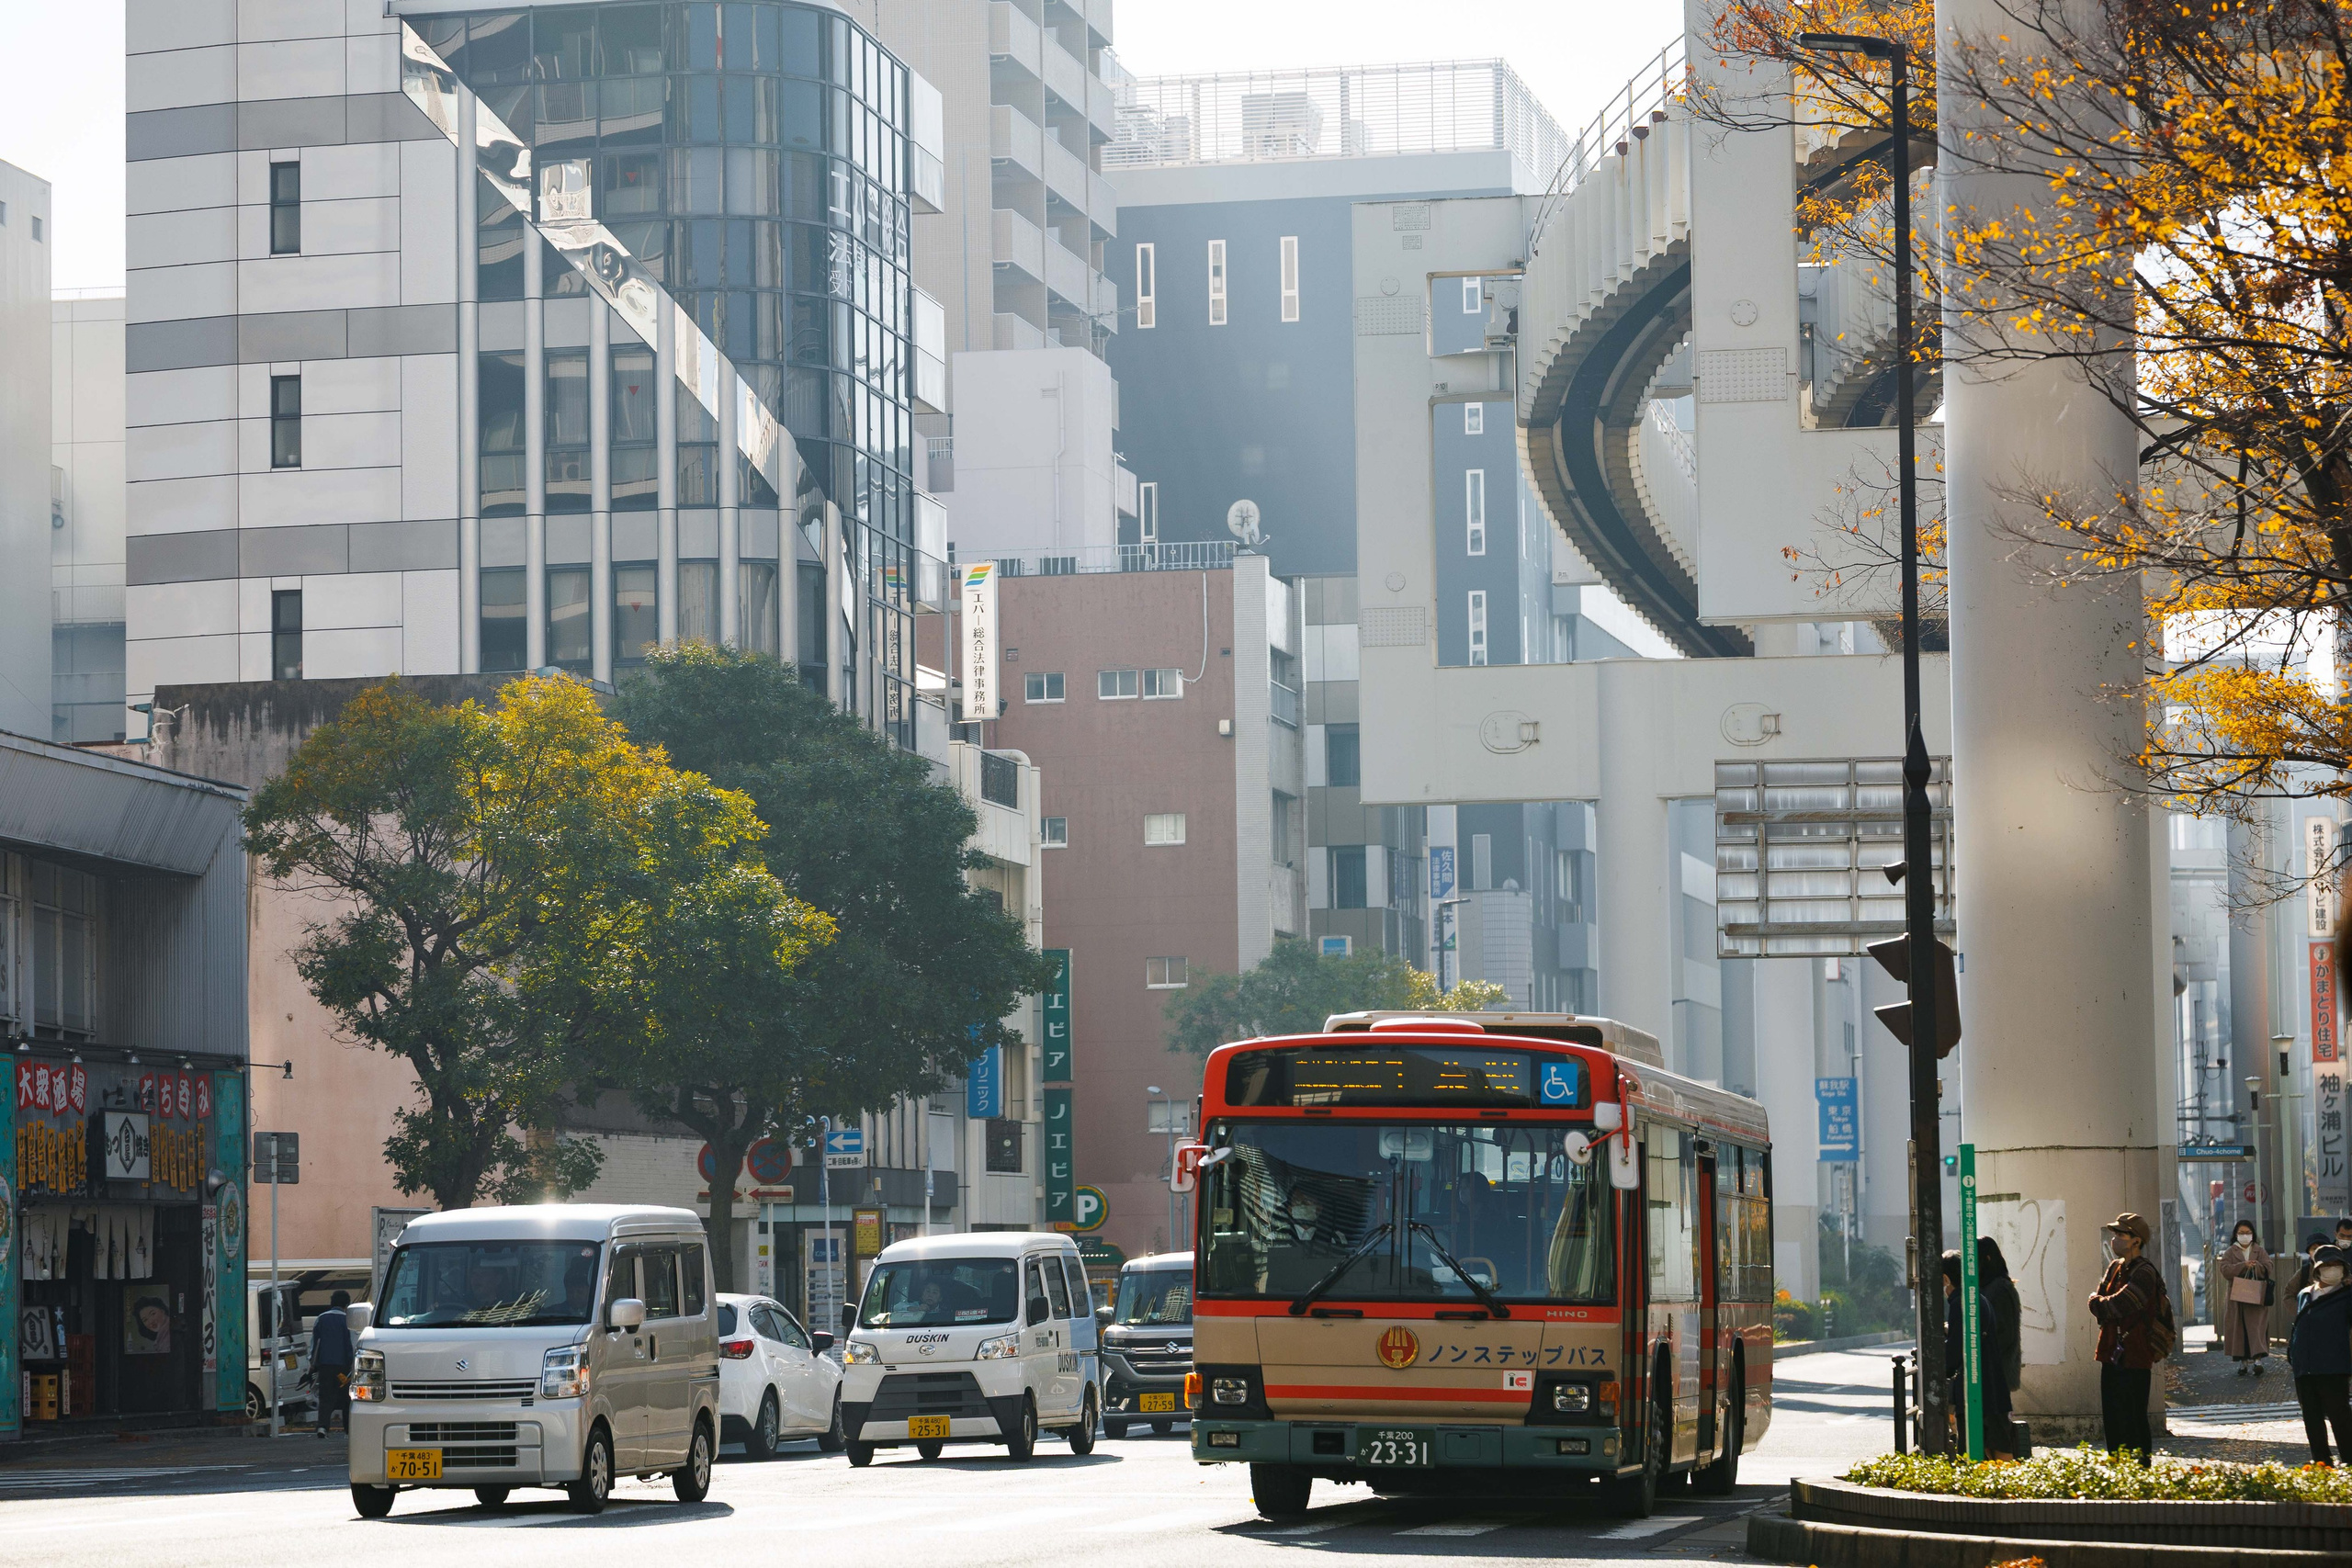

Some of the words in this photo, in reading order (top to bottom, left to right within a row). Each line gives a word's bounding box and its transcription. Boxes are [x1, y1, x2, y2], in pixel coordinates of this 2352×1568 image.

[973, 593, 985, 715] エバー総合法律事務所
[1431, 857, 1441, 896] 法律事務所
[1441, 851, 1453, 883] 佐久間
[2315, 964, 2332, 1057] かまとり住宅
[19, 1066, 85, 1112] 大衆酒場
[1818, 1079, 1849, 1090] 蘇我駅
[1827, 1105, 1851, 1117] 東京
[1828, 1124, 1852, 1134] 船橋
[1050, 1103, 1068, 1207] ノエビア
[1077, 1194, 1099, 1223] P
[202, 1223, 215, 1355] せんべろ
[906, 1334, 950, 1344] DUSKIN
[1057, 1351, 1079, 1372] DUSKIN
[1429, 1345, 1606, 1366] ノンステップバス
[918, 1425, 946, 1436] 25-31
[1370, 1440, 1428, 1465] 23-31
[400, 1461, 437, 1476] 70-51
